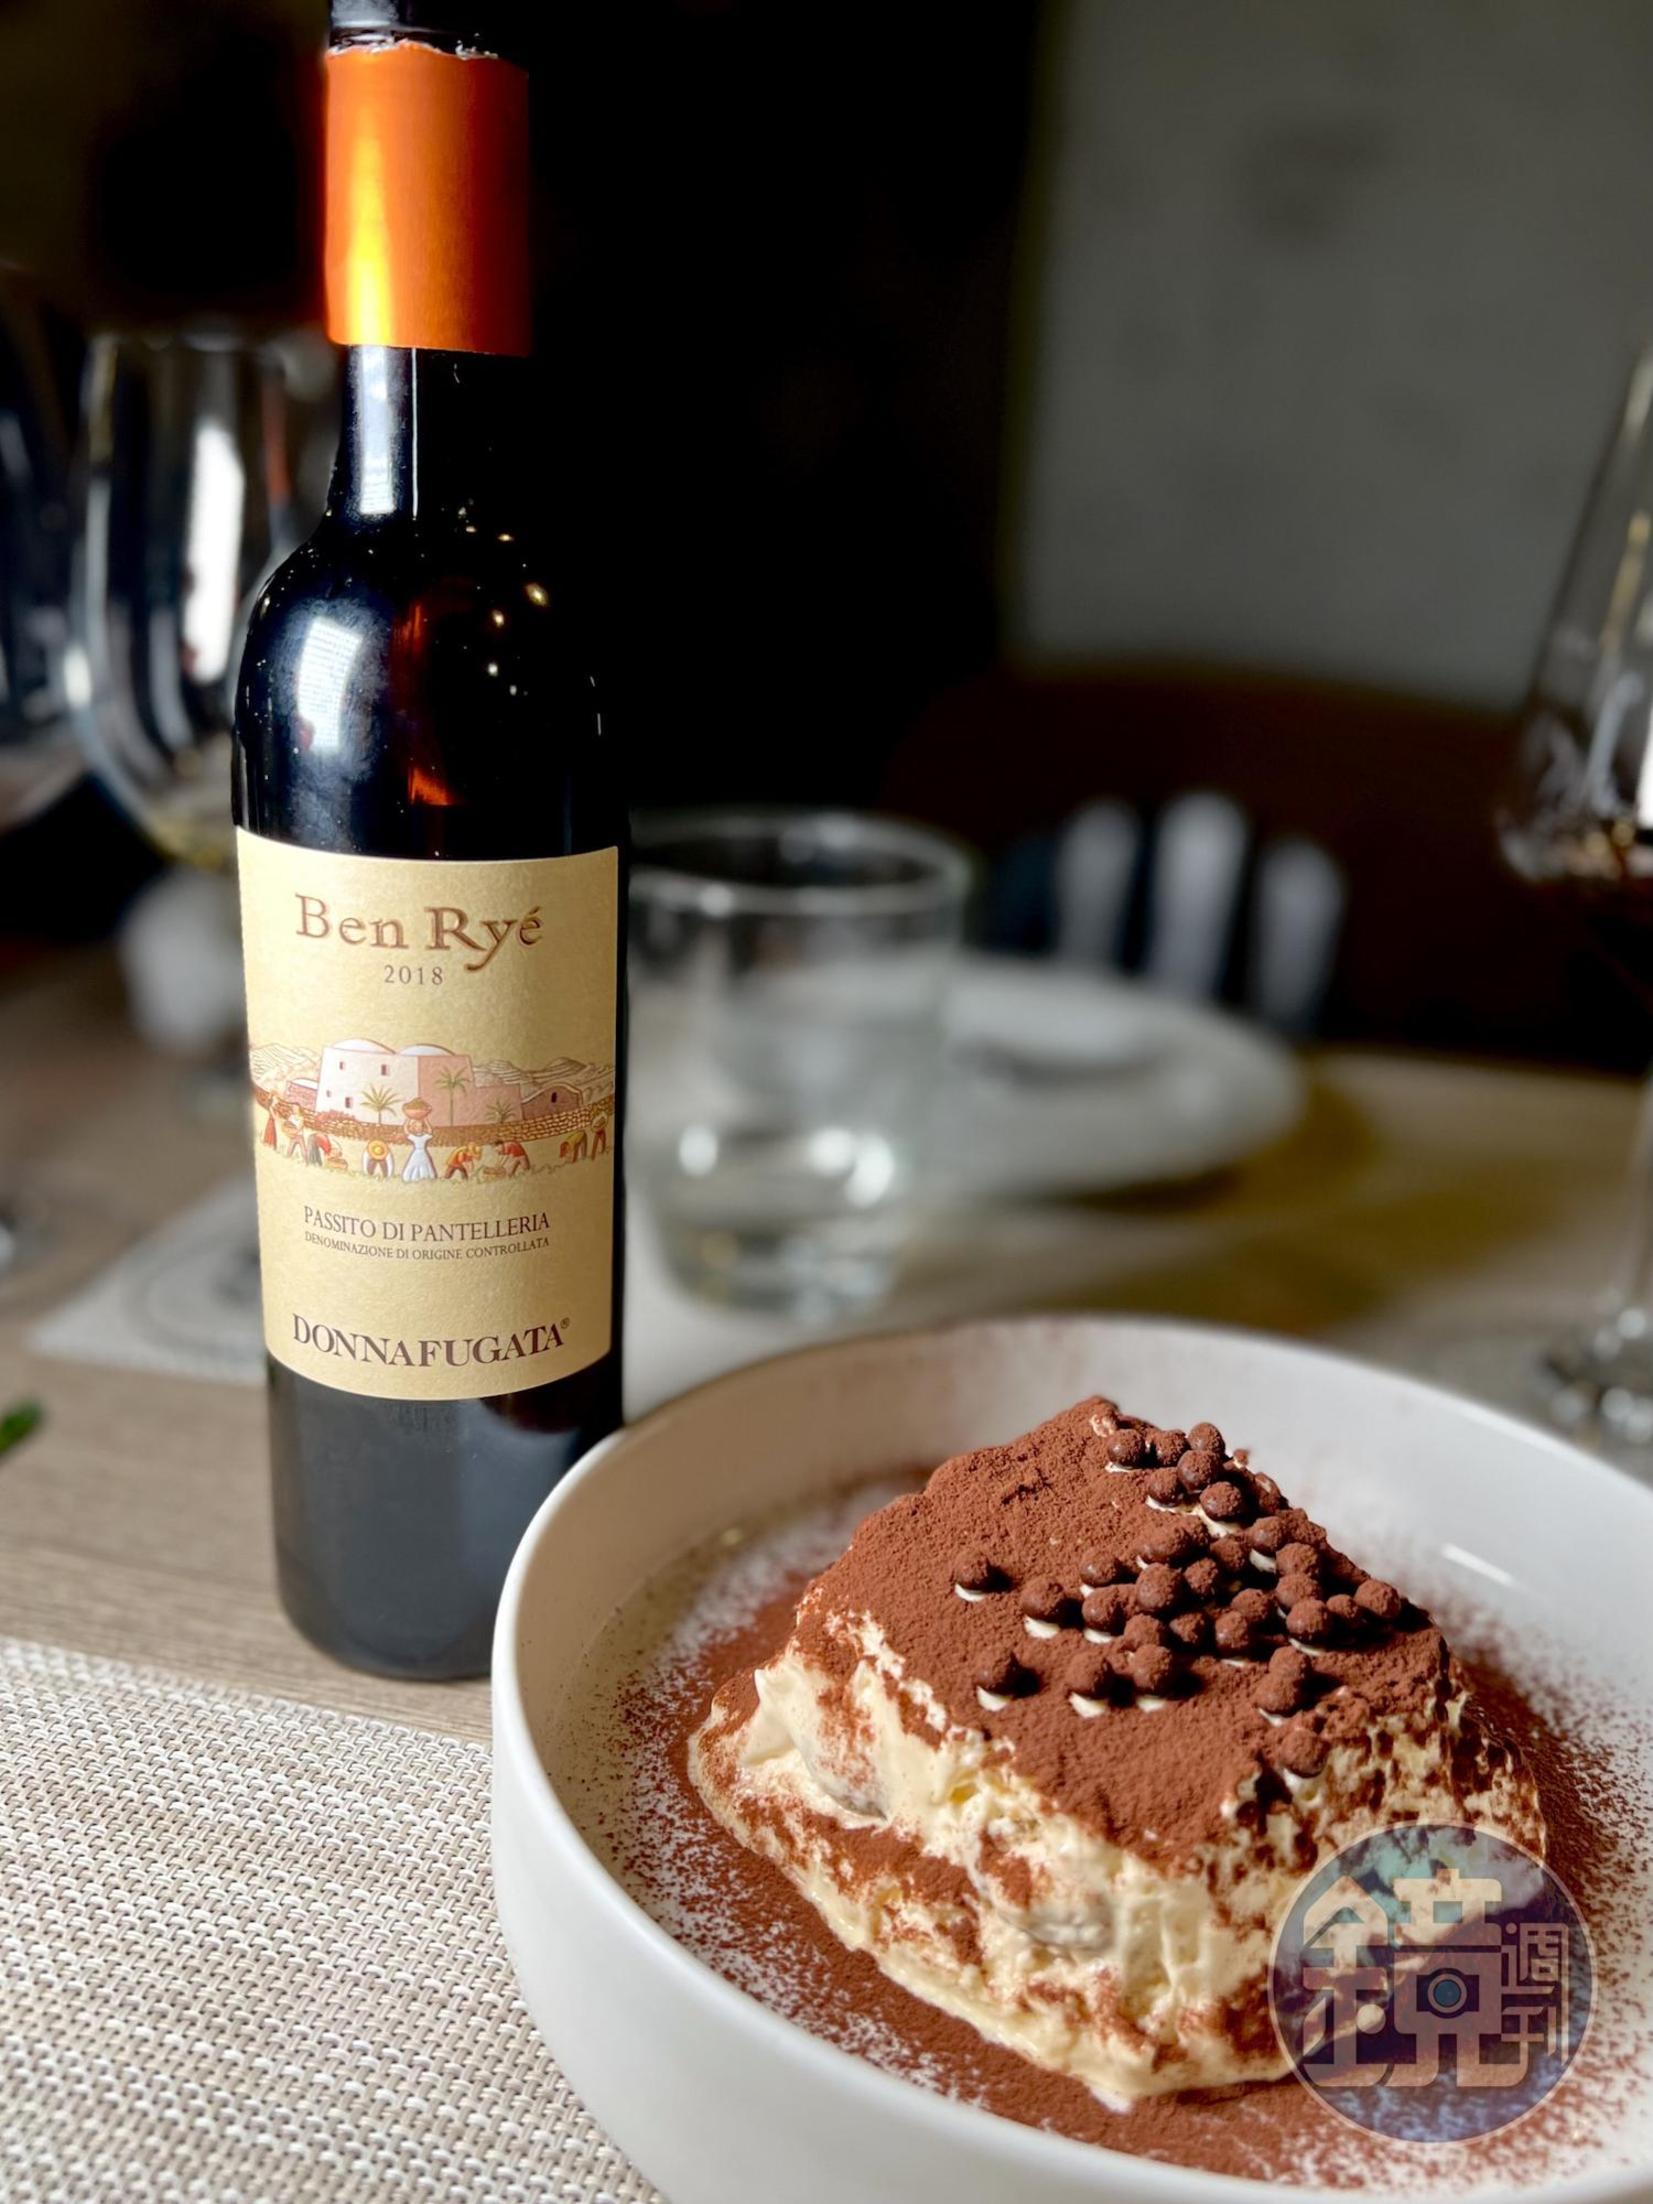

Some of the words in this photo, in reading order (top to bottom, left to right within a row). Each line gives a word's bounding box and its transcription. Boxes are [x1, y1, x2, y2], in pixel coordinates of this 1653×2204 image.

[295, 892, 409, 949] Ben
[424, 906, 545, 973] Ryé
[384, 964, 444, 986] 2018
[304, 1206, 376, 1239] PASSITO
[383, 1222, 404, 1242] DI
[411, 1211, 550, 1242] PANTELLERIA
[304, 1231, 394, 1260] DENOMINAZIONE
[396, 1247, 410, 1260] DI
[412, 1247, 463, 1261] ORIGINE
[465, 1237, 550, 1260] CONTROLLATA
